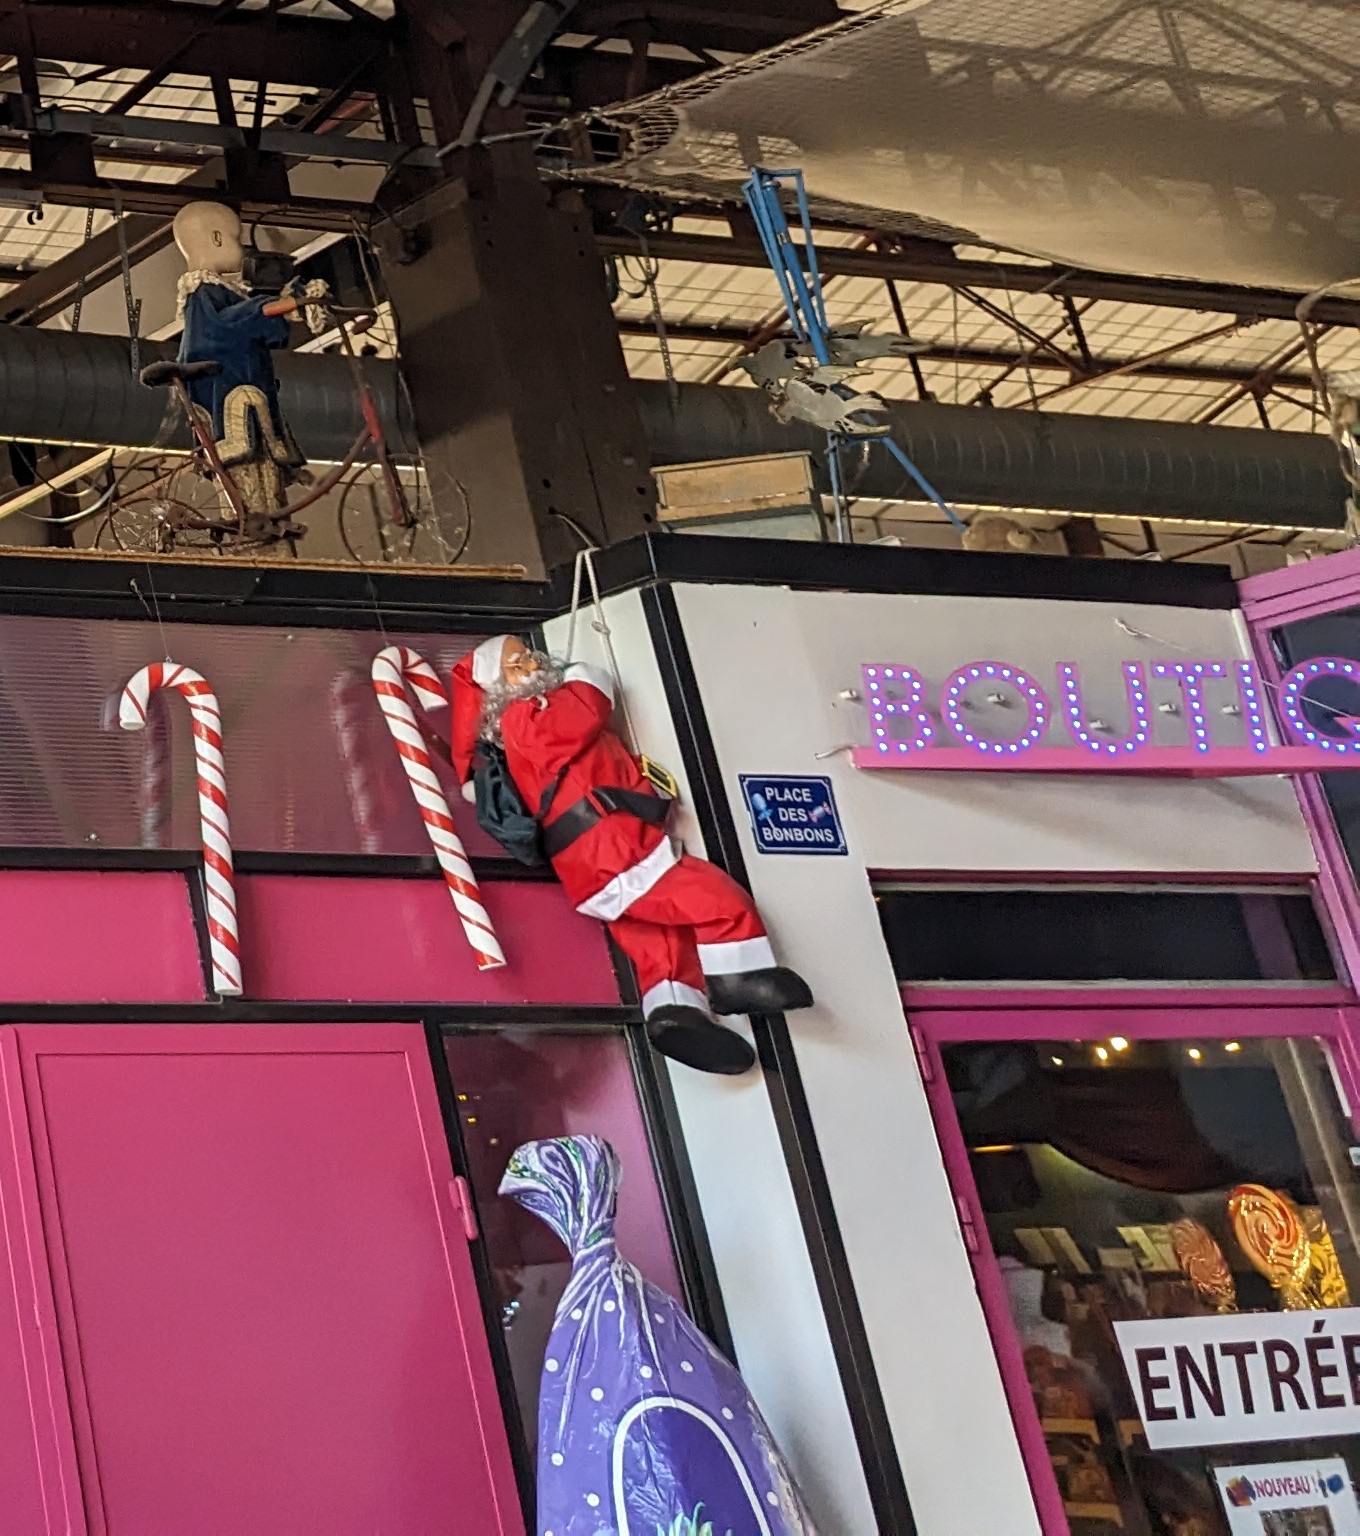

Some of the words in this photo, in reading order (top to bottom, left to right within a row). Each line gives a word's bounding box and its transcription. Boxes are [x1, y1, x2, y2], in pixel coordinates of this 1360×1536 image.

[764, 787, 813, 802] PLACE
[778, 807, 808, 822] DES
[762, 827, 835, 843] BONBONS
[1253, 1475, 1311, 1498] NOUVEAU
